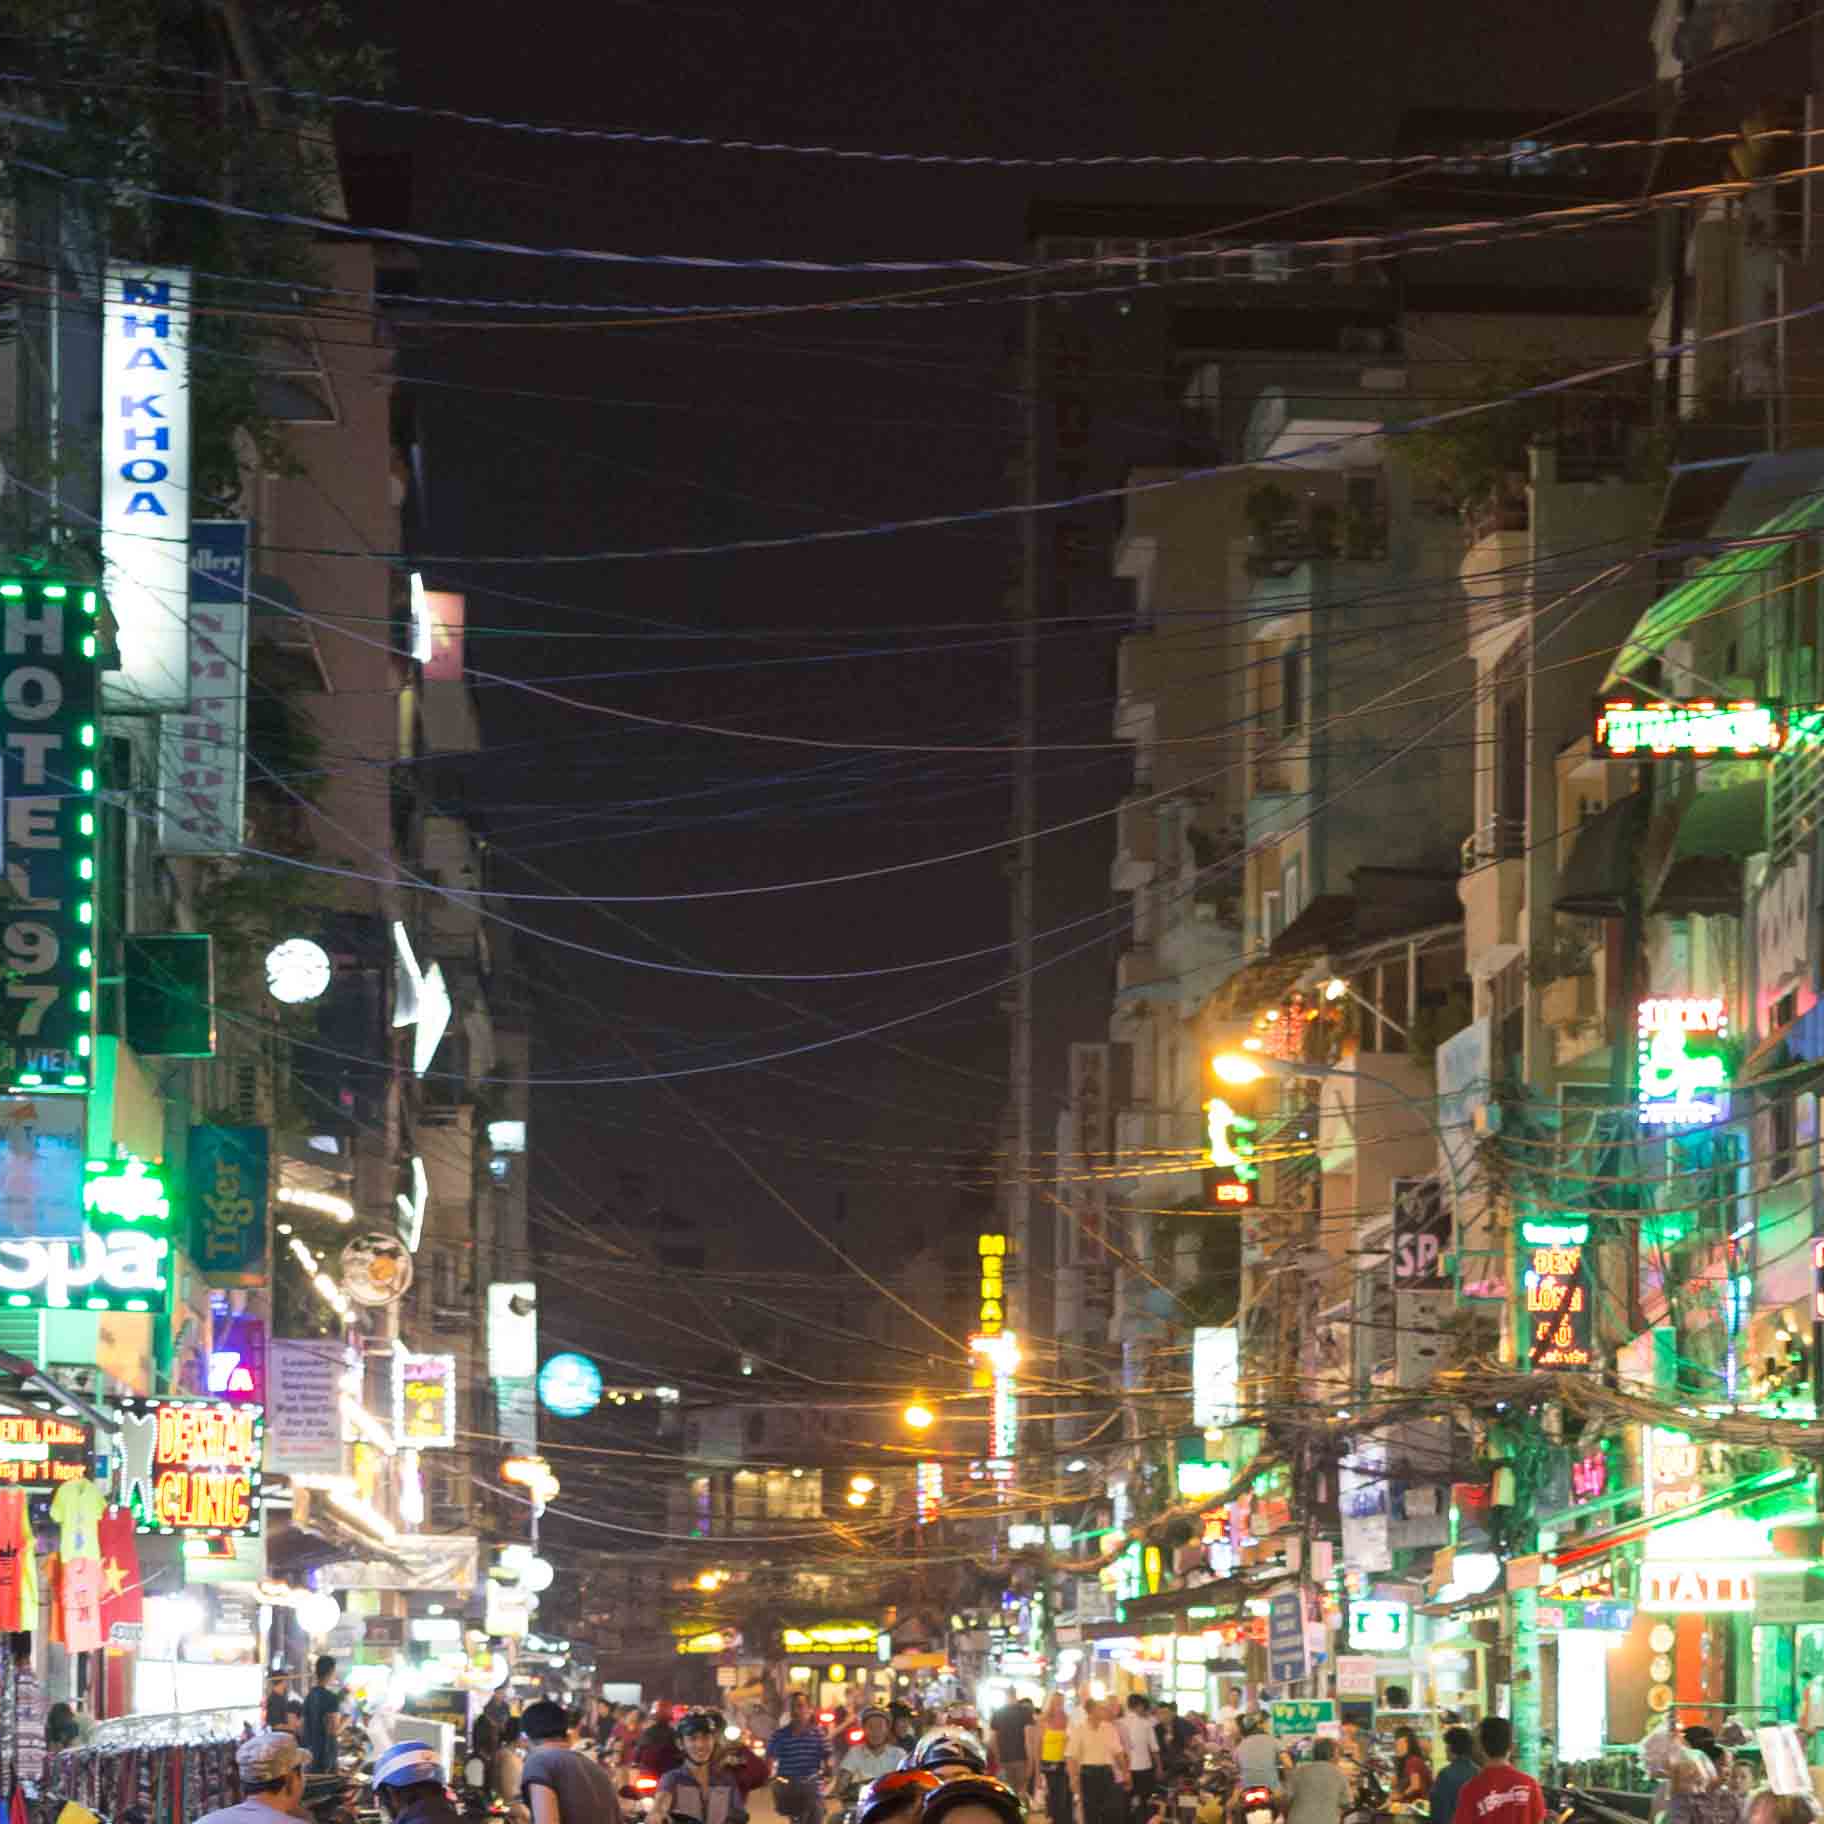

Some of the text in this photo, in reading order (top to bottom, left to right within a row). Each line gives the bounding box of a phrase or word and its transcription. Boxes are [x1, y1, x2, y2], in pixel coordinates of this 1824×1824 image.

[120, 393, 170, 516] KHOA
[2, 600, 64, 911] HOTEL
[203, 1160, 254, 1258] Tiger
[158, 1407, 258, 1466] DENTAL
[157, 1470, 251, 1528] CLINIC
